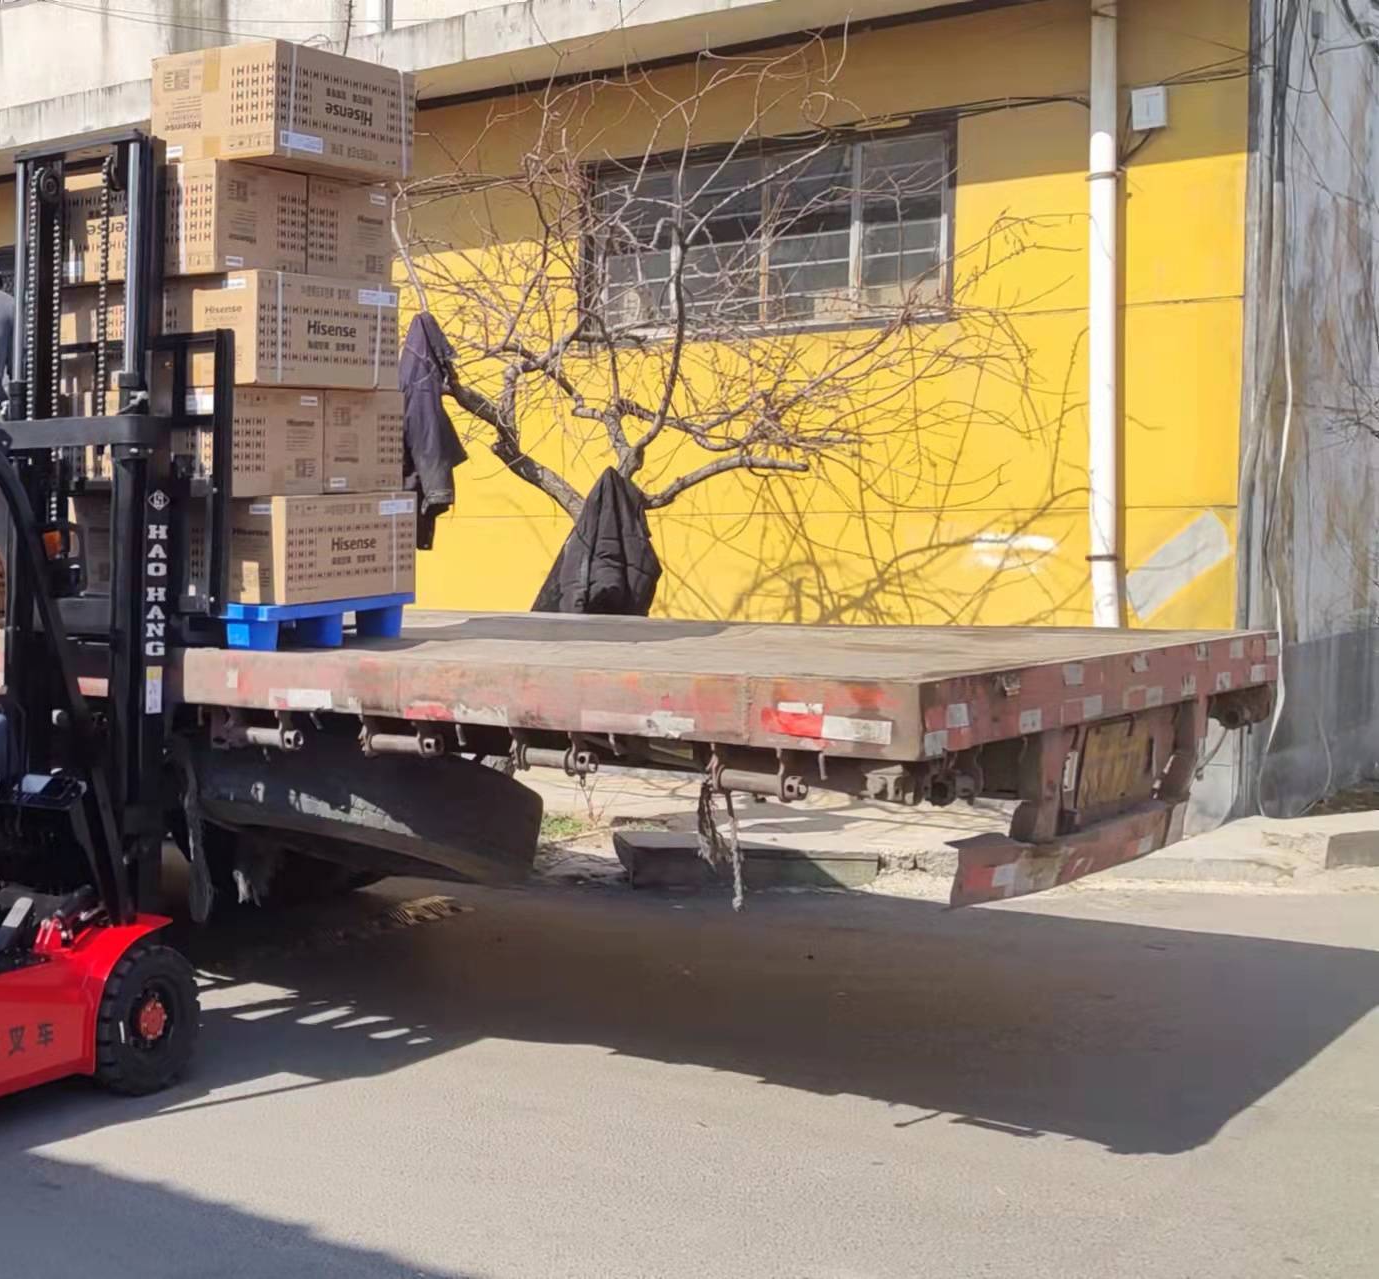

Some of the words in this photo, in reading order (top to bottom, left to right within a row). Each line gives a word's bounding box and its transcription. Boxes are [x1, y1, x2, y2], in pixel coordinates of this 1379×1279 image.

[325, 102, 373, 127] Hisense
[204, 305, 242, 314] Hisense
[306, 319, 357, 338] Hisense
[331, 536, 376, 551] Hisense
